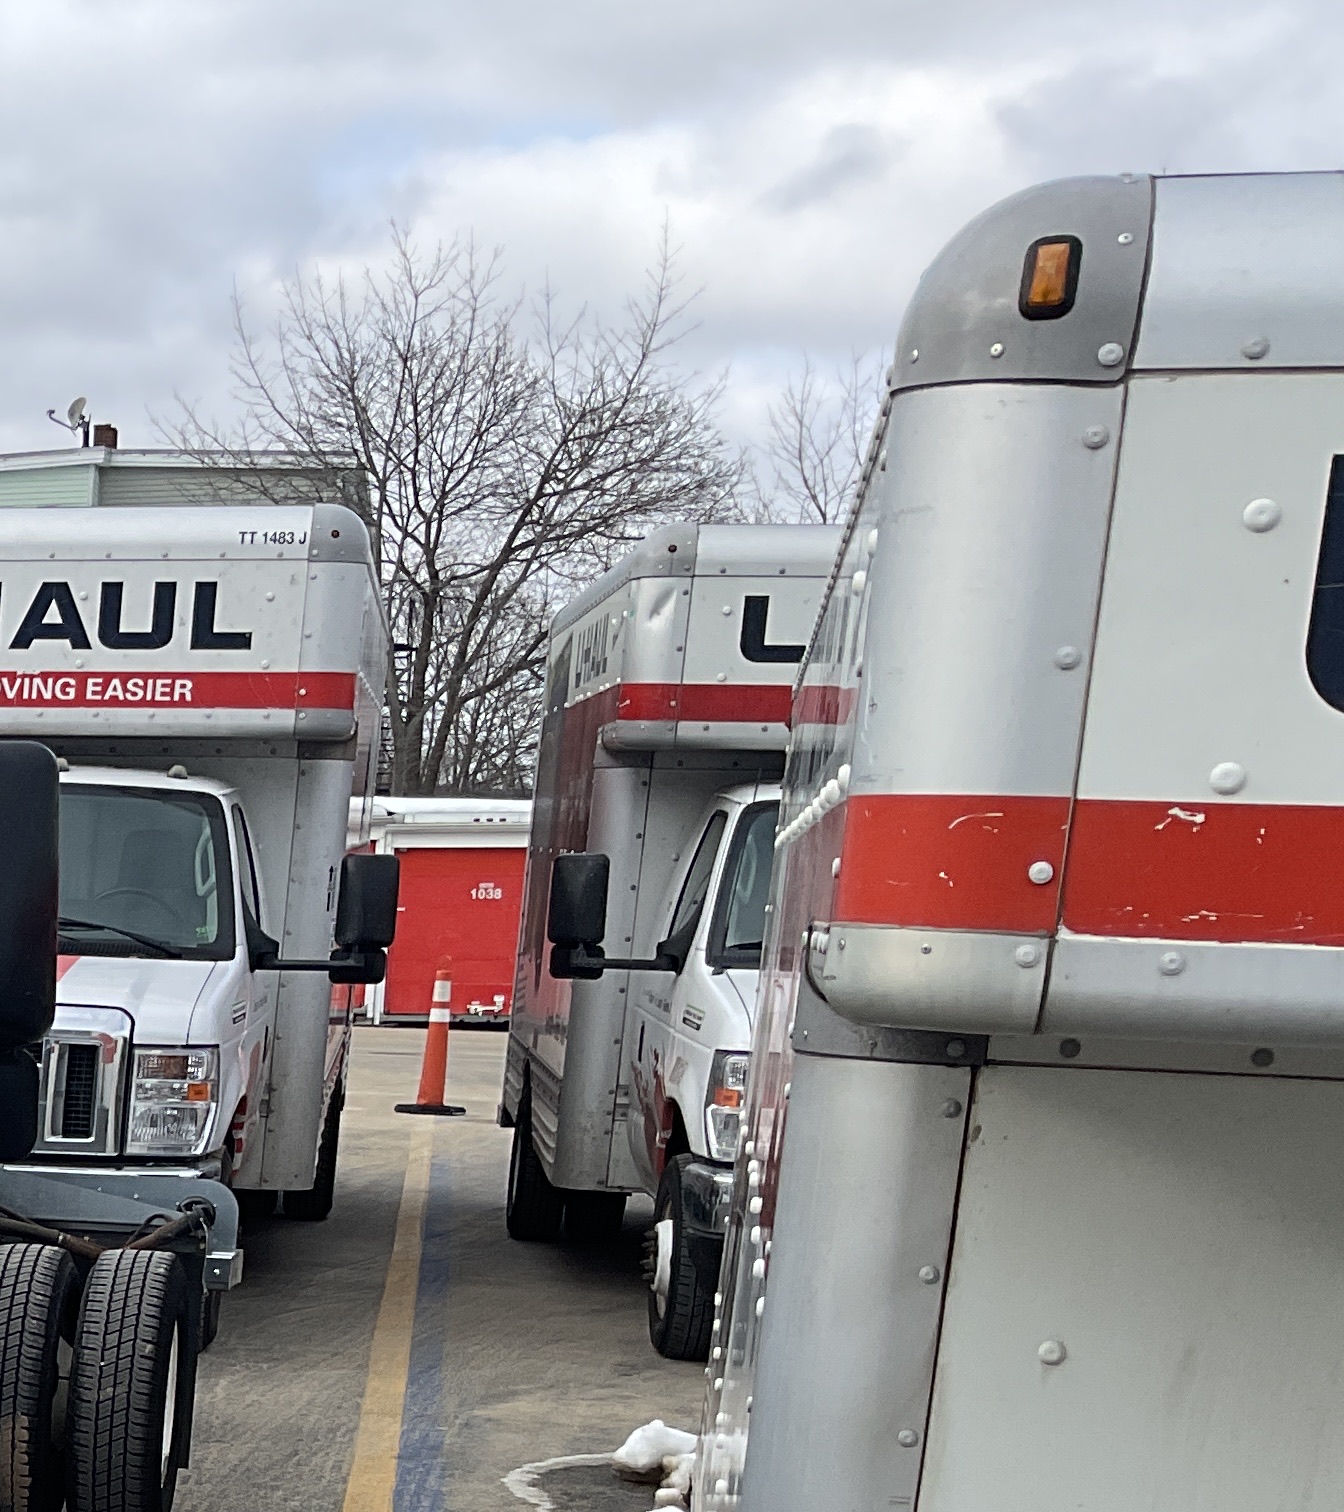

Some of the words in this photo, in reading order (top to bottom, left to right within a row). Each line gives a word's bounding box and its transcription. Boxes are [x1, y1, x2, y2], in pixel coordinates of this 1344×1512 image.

[238, 531, 258, 545] TT
[262, 531, 295, 545] 1483
[298, 531, 308, 545] J
[85, 677, 194, 702] EASIER
[470, 888, 503, 900] 1038
